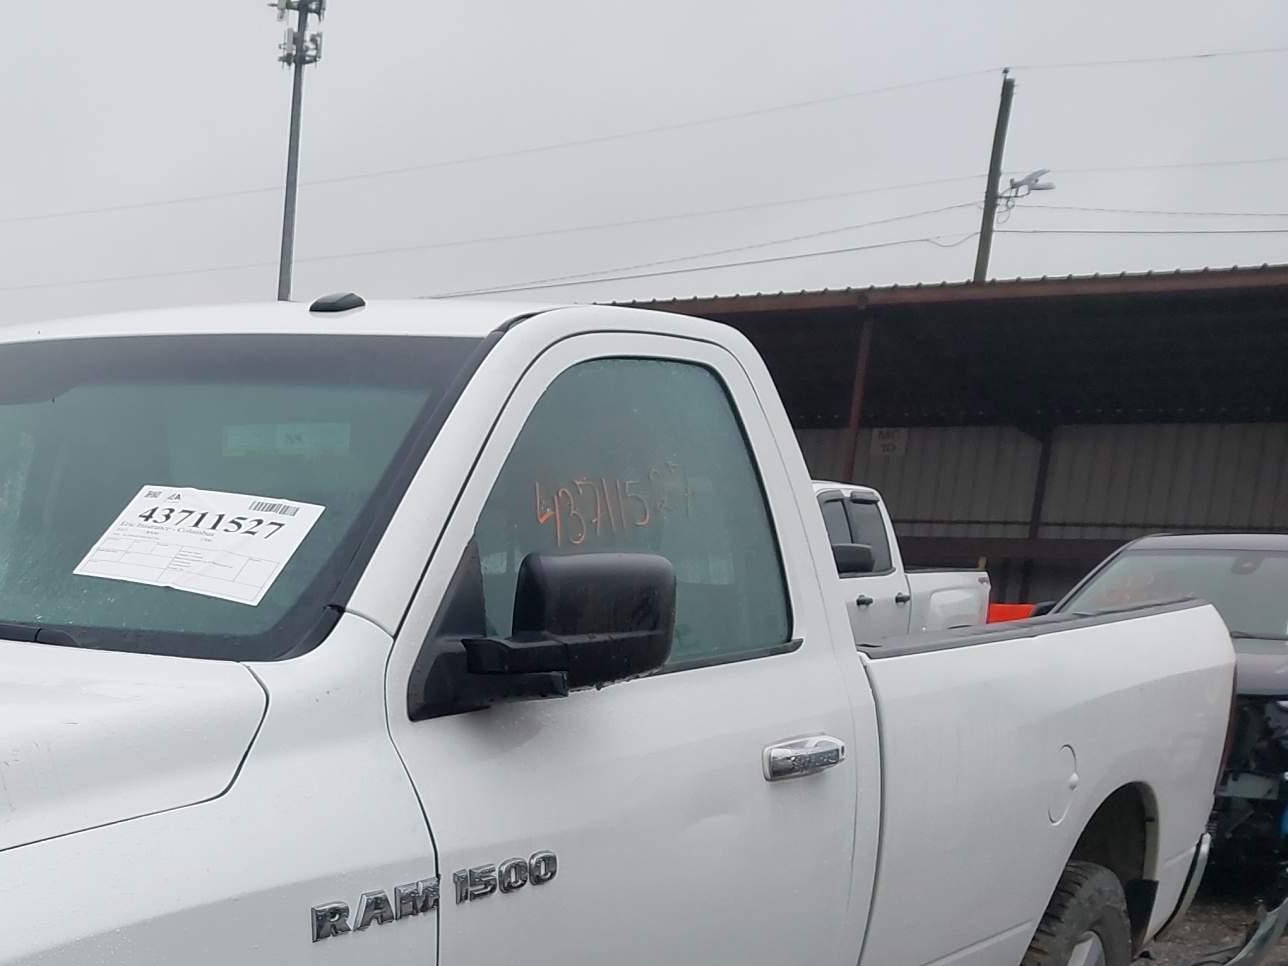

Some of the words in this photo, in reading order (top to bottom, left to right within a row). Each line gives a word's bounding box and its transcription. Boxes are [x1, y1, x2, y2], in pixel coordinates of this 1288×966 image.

[138, 506, 286, 540] 43711527
[311, 875, 440, 943] RAM
[452, 849, 558, 905] 1500
